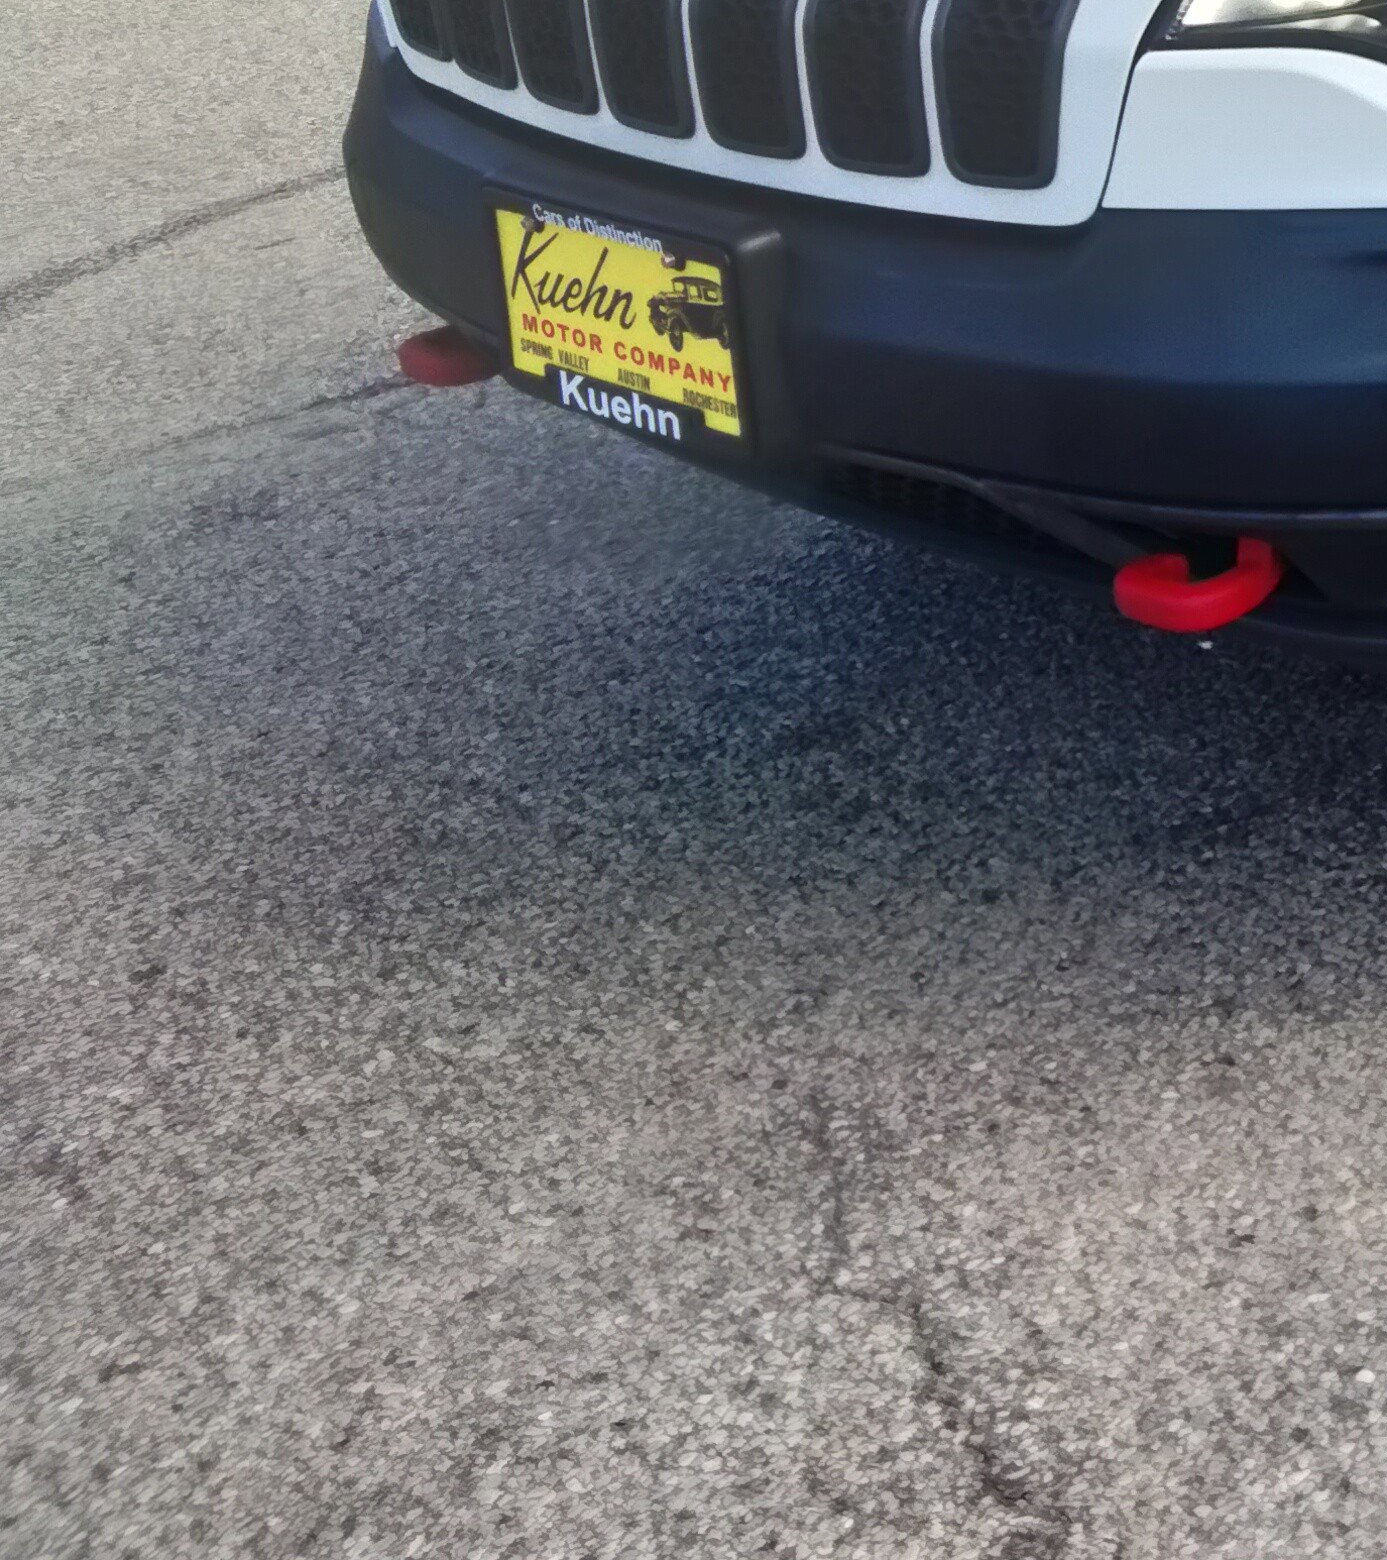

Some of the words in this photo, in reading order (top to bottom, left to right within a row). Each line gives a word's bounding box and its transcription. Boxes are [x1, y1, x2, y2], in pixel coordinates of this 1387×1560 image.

[532, 203, 566, 227] Cars
[567, 215, 582, 232] of
[583, 217, 664, 254] Distinction
[510, 228, 637, 330] Kuehn
[521, 313, 603, 354] MOTOR
[614, 341, 731, 393] COMPANY
[558, 349, 590, 374] VALLEY
[617, 368, 651, 391] AUSTIN
[558, 369, 682, 440] Kuehn
